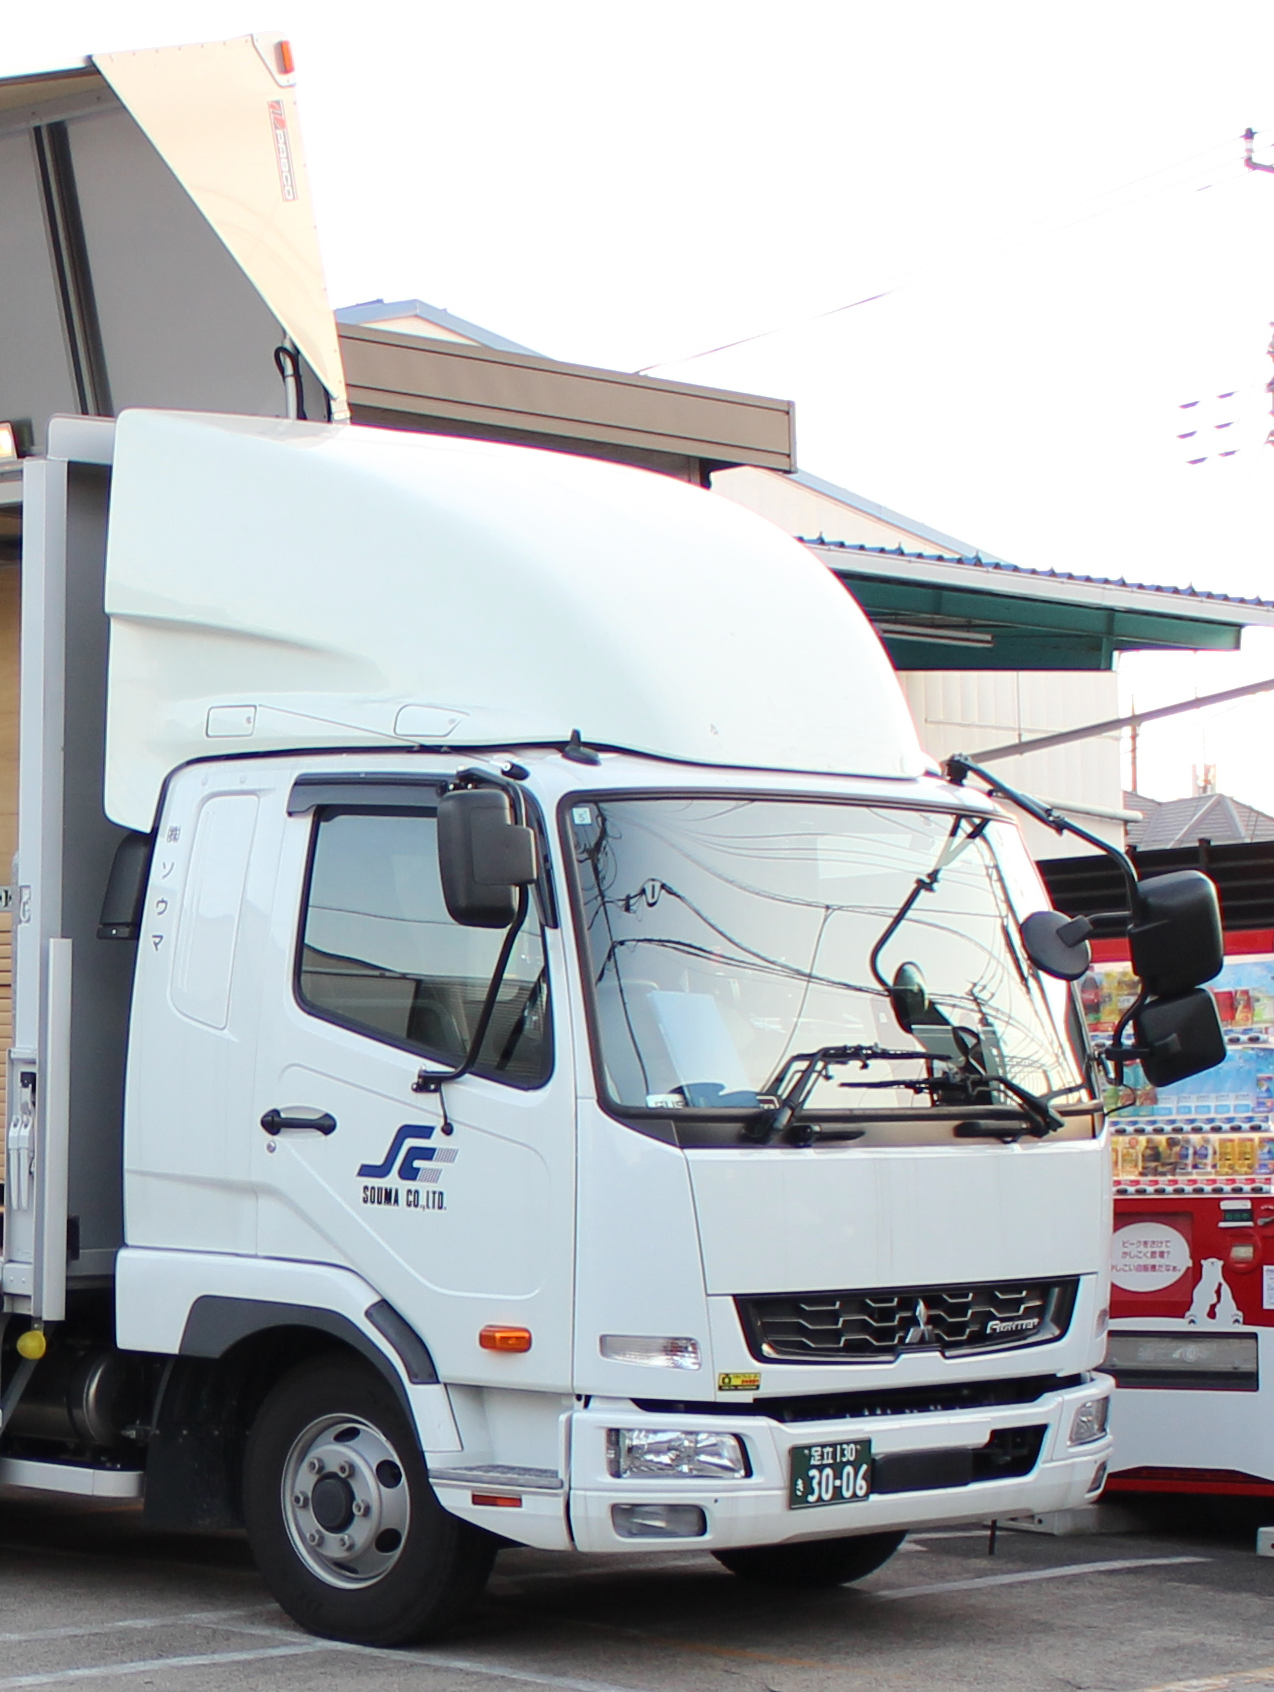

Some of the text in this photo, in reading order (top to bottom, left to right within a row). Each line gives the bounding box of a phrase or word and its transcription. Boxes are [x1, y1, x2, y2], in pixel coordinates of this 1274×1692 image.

[362, 1185, 399, 1207] SOUMA
[809, 1443, 856, 1466] 足立 130
[806, 1463, 868, 1503] 30-06
